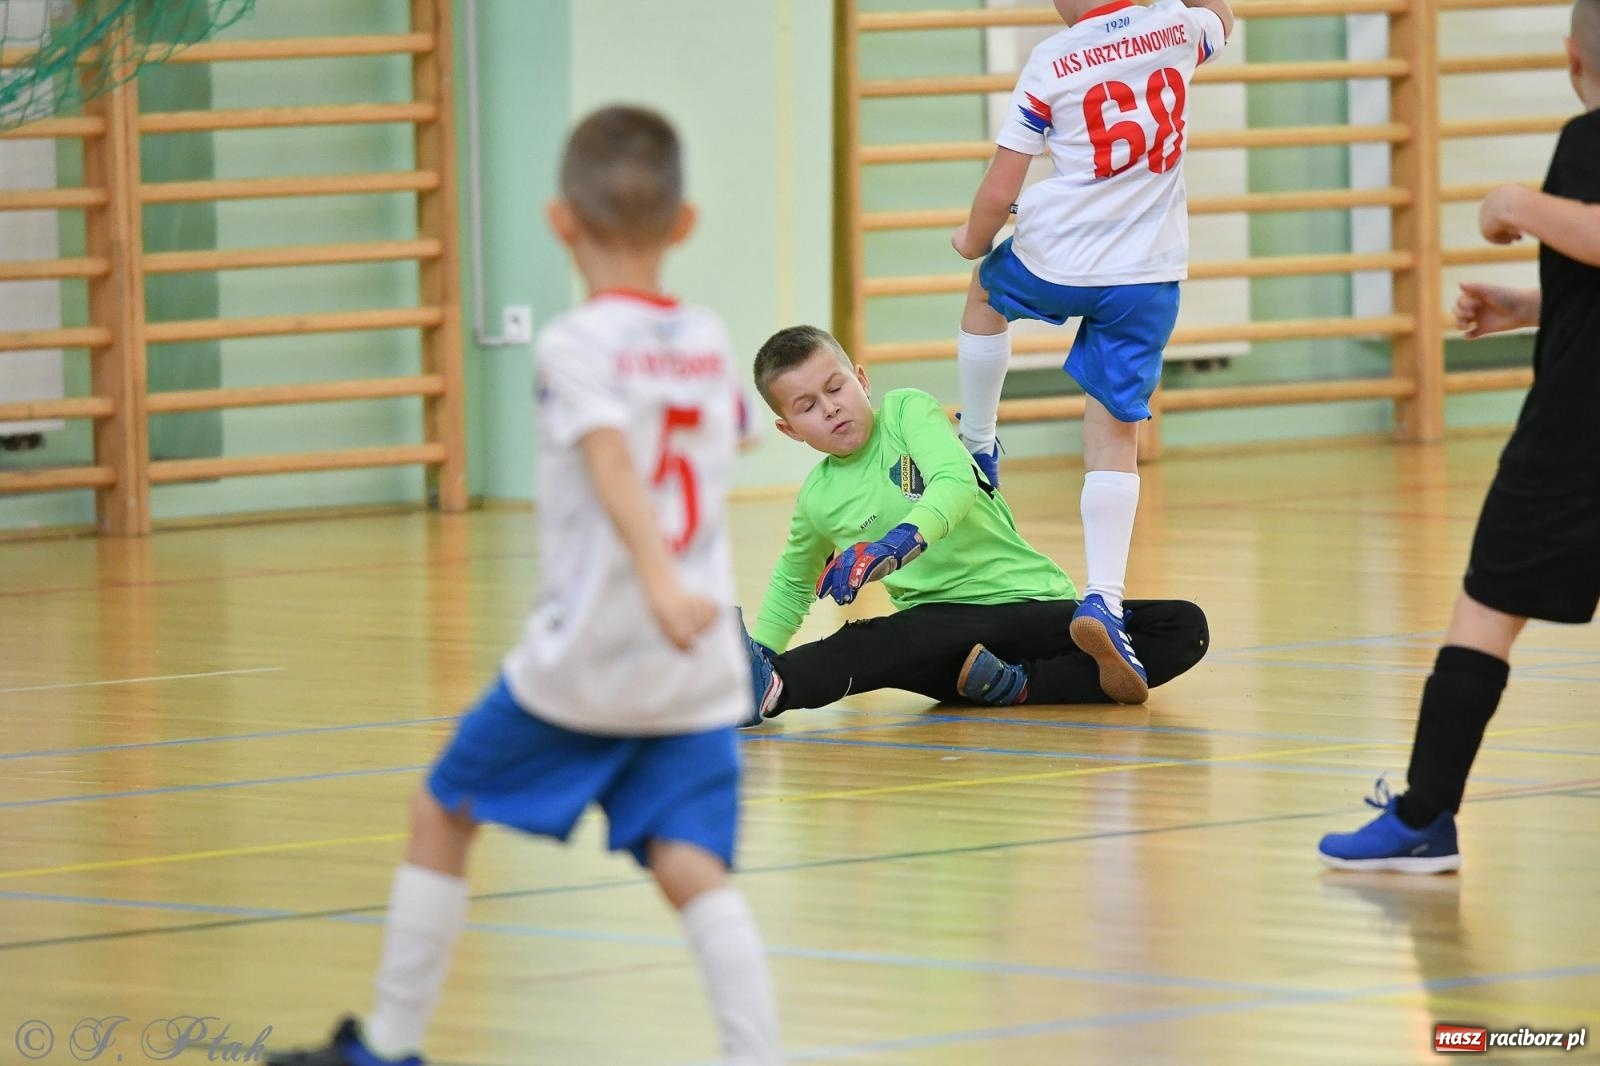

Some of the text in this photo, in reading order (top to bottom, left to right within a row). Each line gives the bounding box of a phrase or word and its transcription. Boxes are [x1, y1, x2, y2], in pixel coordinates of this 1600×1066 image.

[1053, 24, 1187, 78] LKS KRZYŻANOWICE
[1105, 16, 1130, 33] 1920
[1083, 67, 1186, 179] 68
[652, 404, 702, 556] 5
[860, 514, 877, 530] KIPSTA
